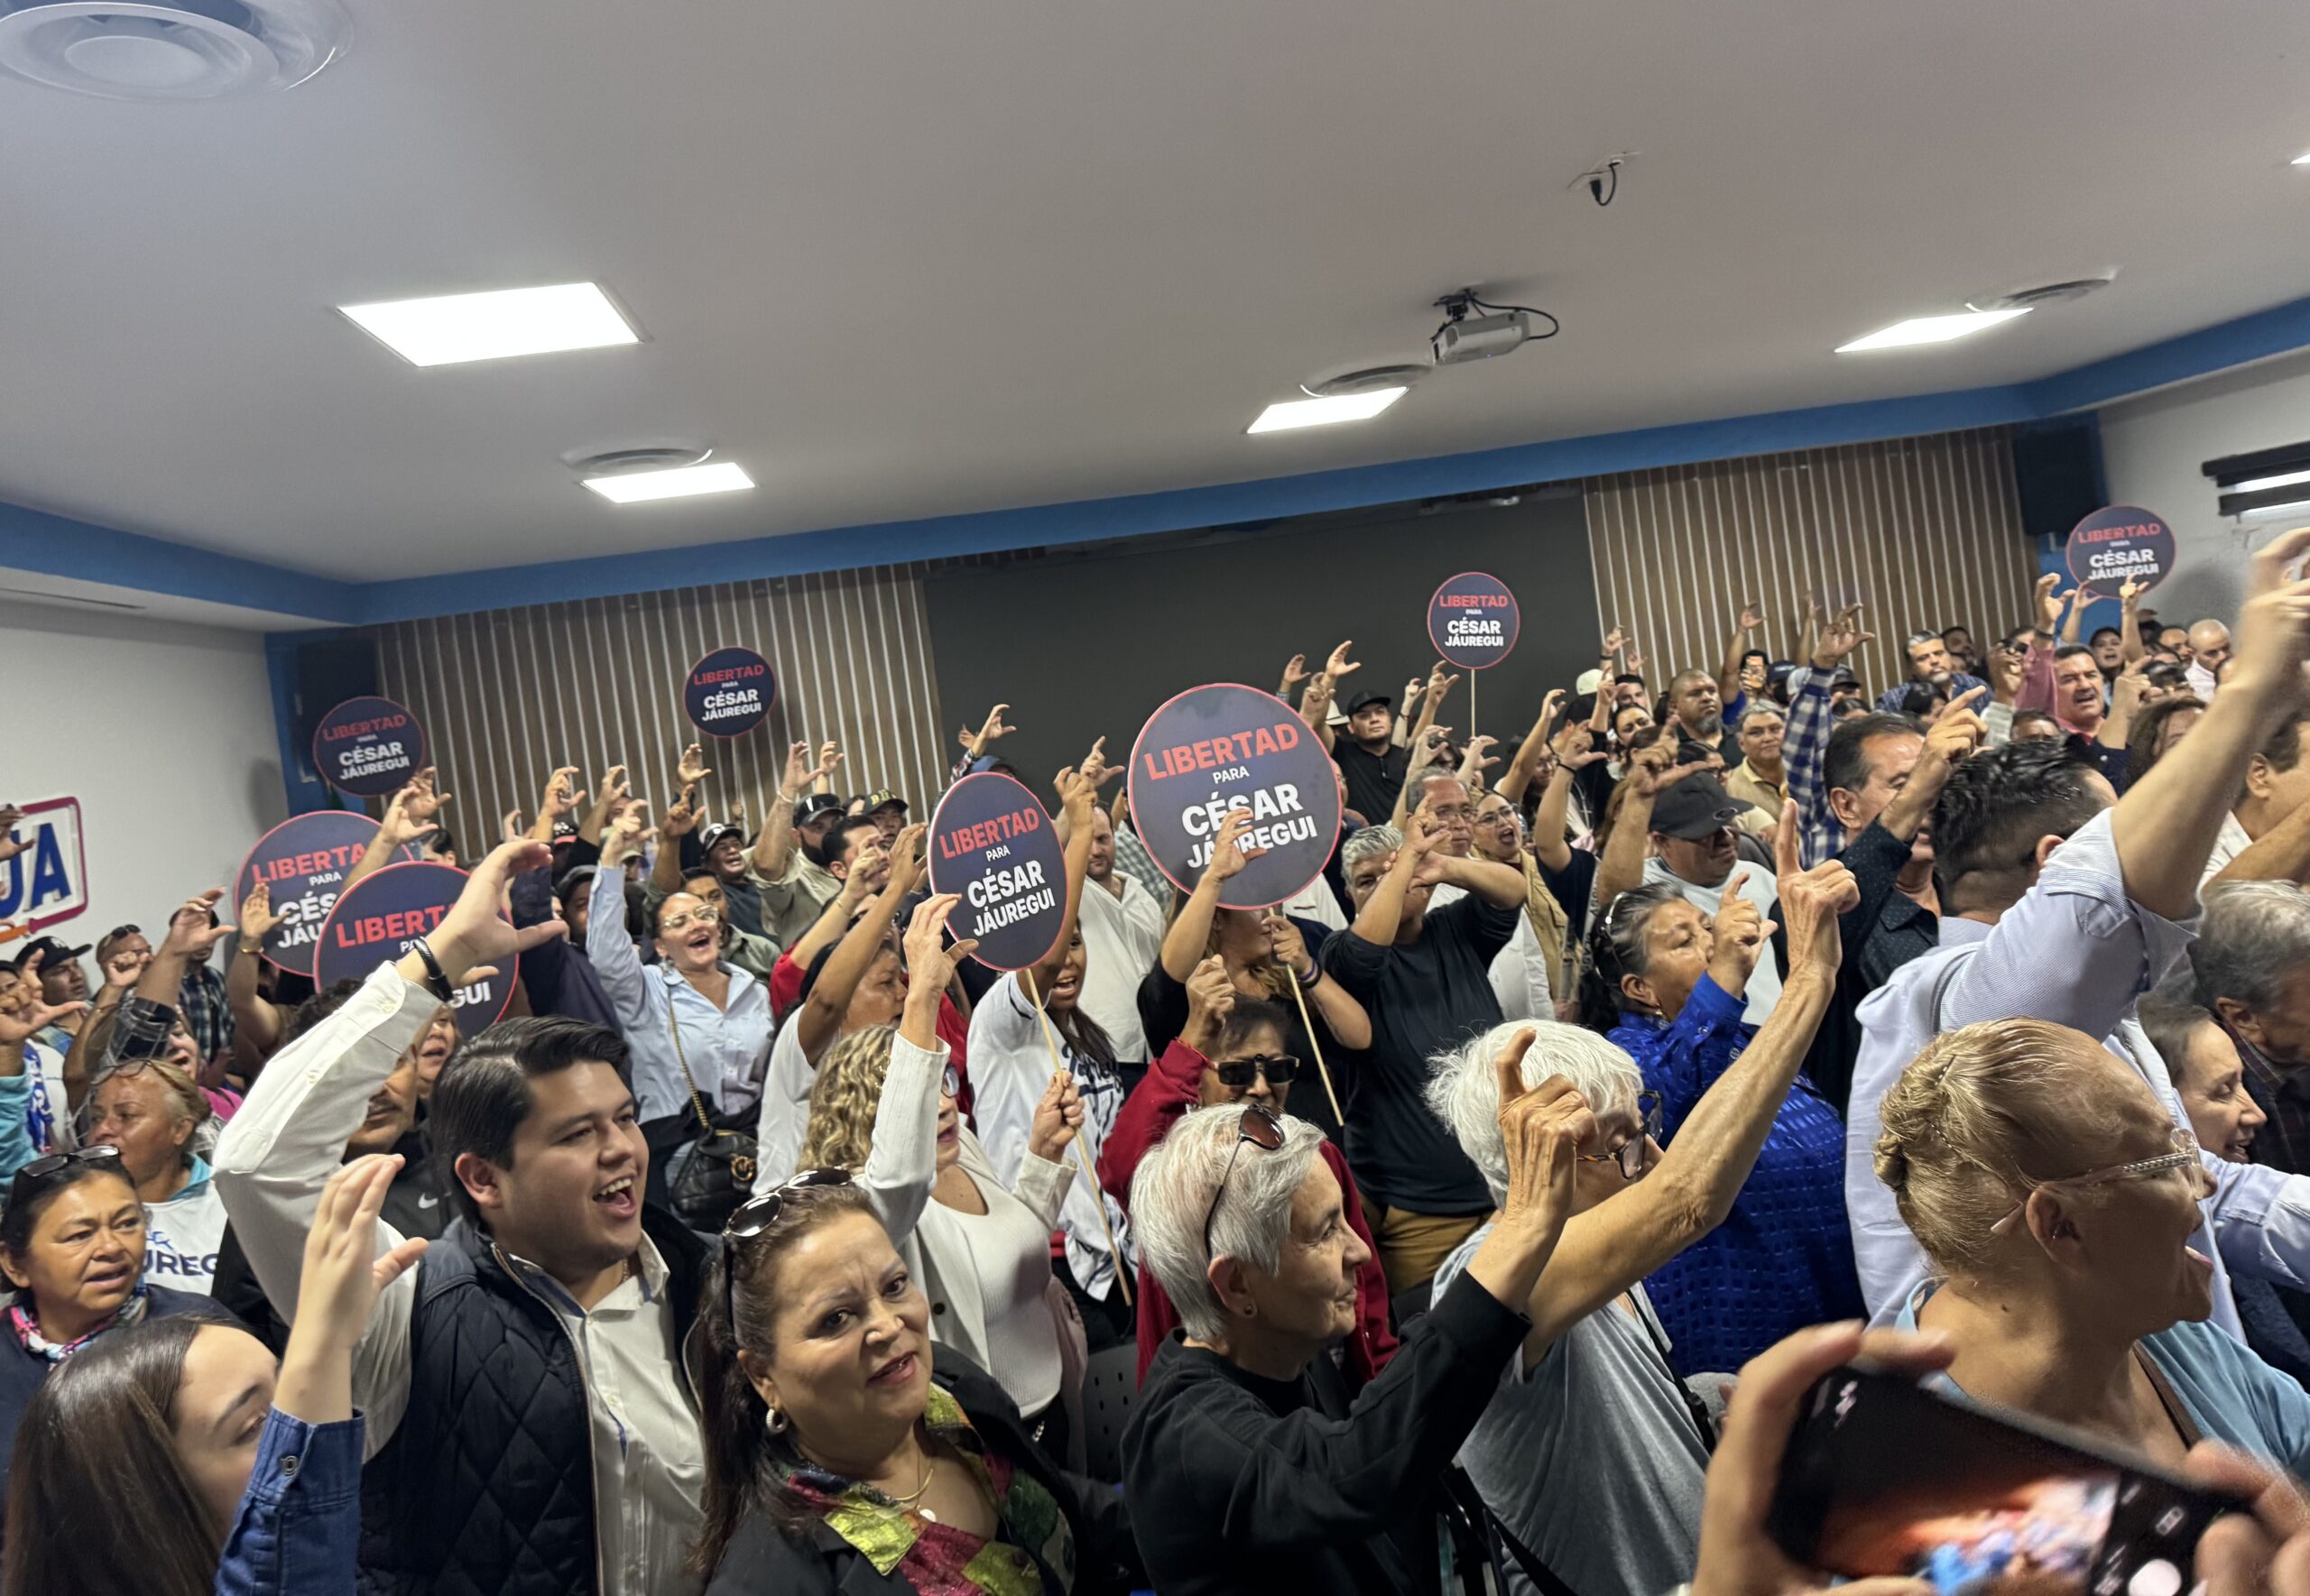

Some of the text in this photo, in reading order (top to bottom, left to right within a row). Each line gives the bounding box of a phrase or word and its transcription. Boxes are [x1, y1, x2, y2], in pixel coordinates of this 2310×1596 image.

[2078, 523, 2161, 543] LIBERTAD
[2089, 549, 2156, 567] CÉSAR
[1439, 595, 1509, 607] LIBERTAD
[1447, 616, 1502, 634] CÉSAR
[1445, 633, 1504, 646] JÁUREGUI
[694, 665, 764, 686] LIBERTAD
[704, 688, 759, 708] CÉSAR
[701, 702, 762, 721] JÁUREGUI
[323, 715, 407, 741] LIBERTAD
[338, 742, 404, 766] CÉSAR
[1144, 724, 1299, 780] LIBERTAD
[339, 755, 411, 780] JÁUREGUI
[1213, 766, 1250, 784] PARA
[938, 807, 1040, 859] LIBERTAD
[252, 843, 366, 883] LIBERTA
[985, 844, 1011, 862] PARA
[309, 872, 342, 887] PARA
[967, 860, 1046, 908] CÉSAR
[278, 890, 338, 925] CÉS
[973, 888, 1056, 936] JÁUREGUI
[336, 903, 455, 948] LIBERT
